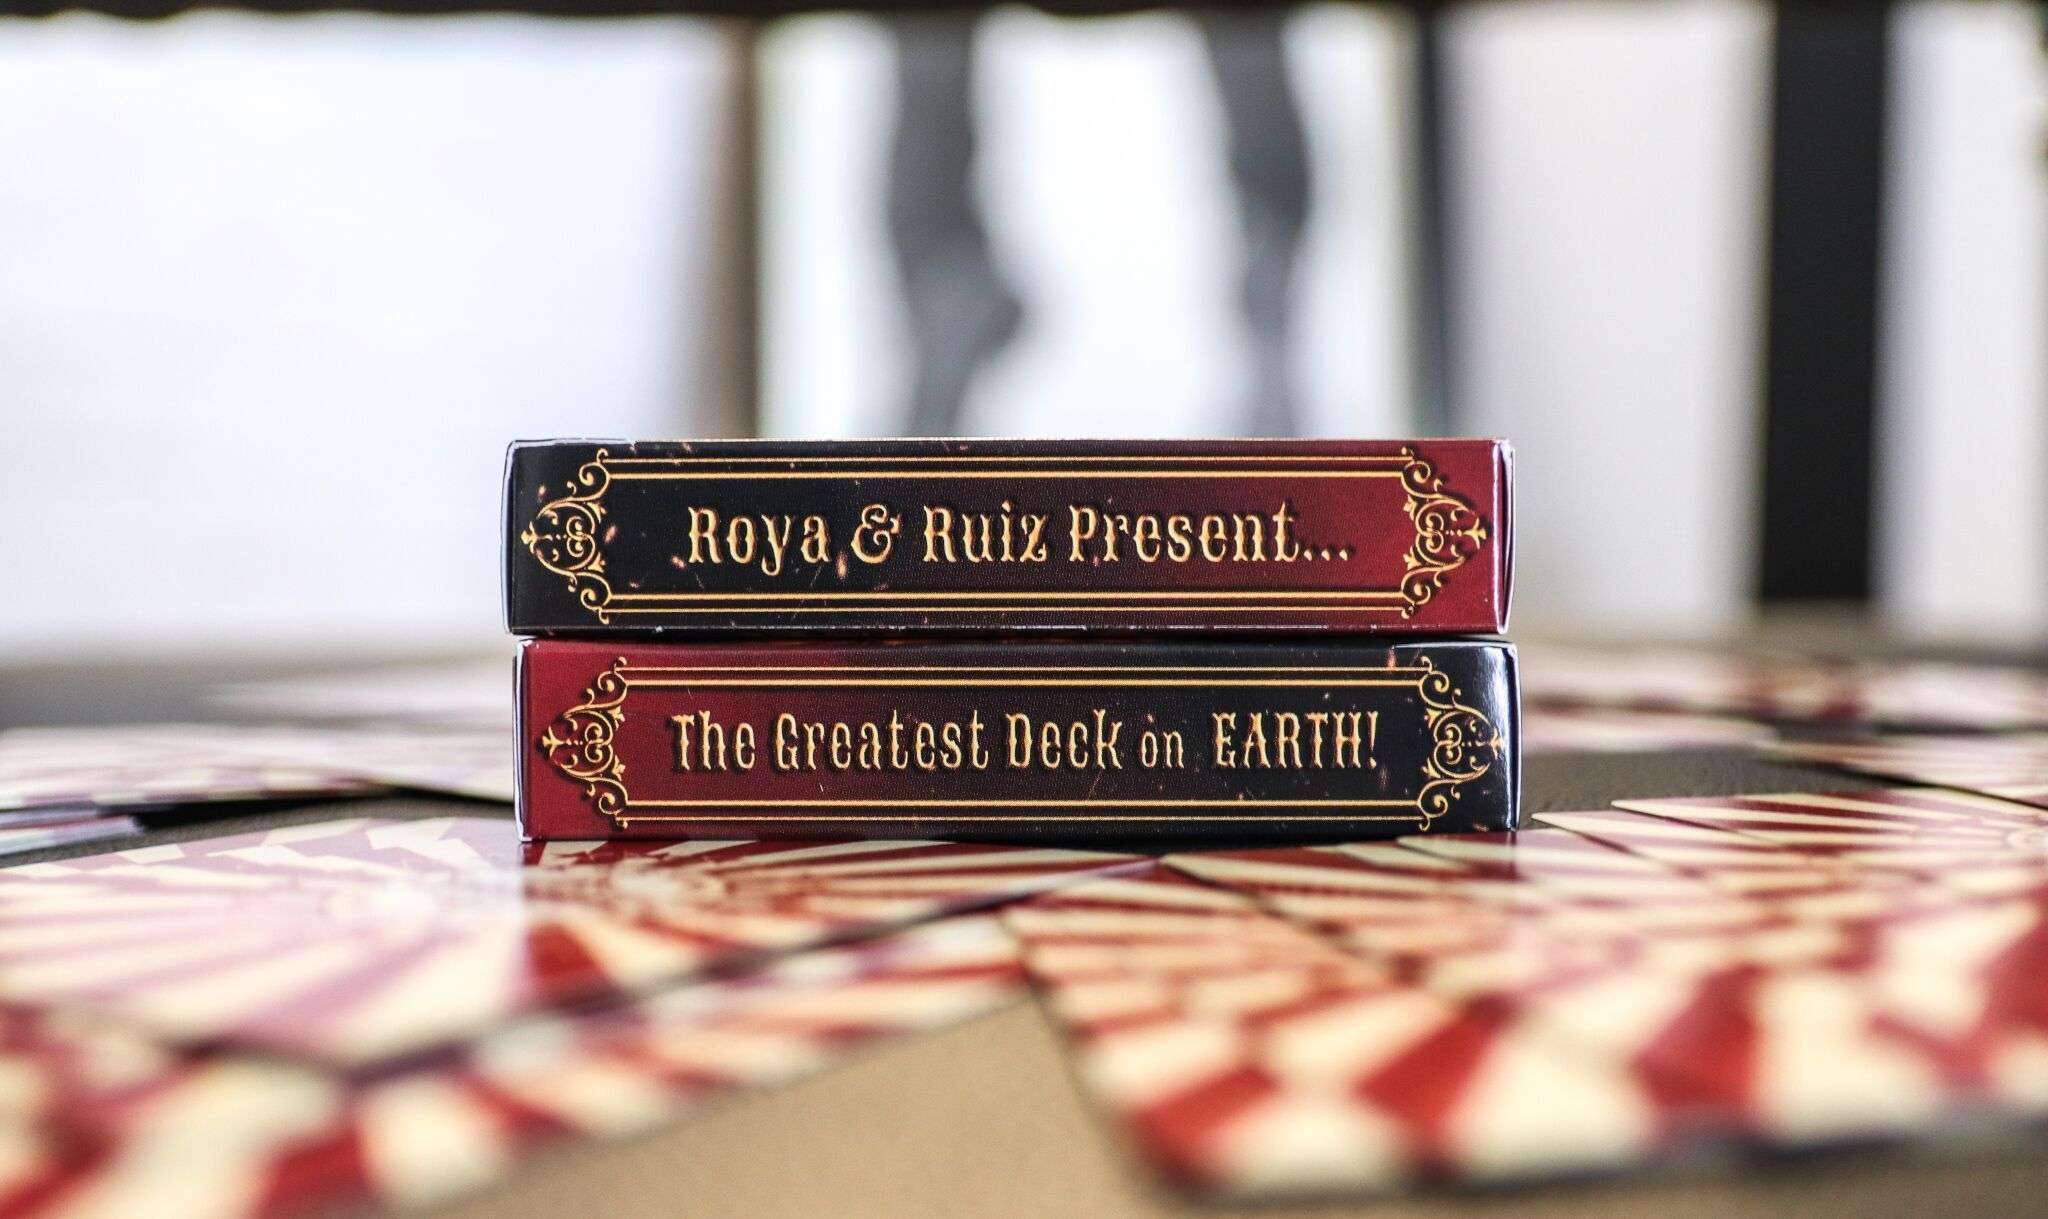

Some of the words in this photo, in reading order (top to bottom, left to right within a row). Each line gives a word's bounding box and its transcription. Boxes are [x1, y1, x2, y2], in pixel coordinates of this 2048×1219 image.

[688, 505, 830, 576] Roya
[850, 503, 900, 564] &
[922, 502, 1047, 563] Ruiz
[1069, 501, 1350, 563] Present...
[671, 710, 756, 770] The
[775, 709, 989, 769] Greatest
[1006, 709, 1123, 769] Deck
[1140, 730, 1185, 768] on
[1212, 710, 1379, 769] EARTH!
